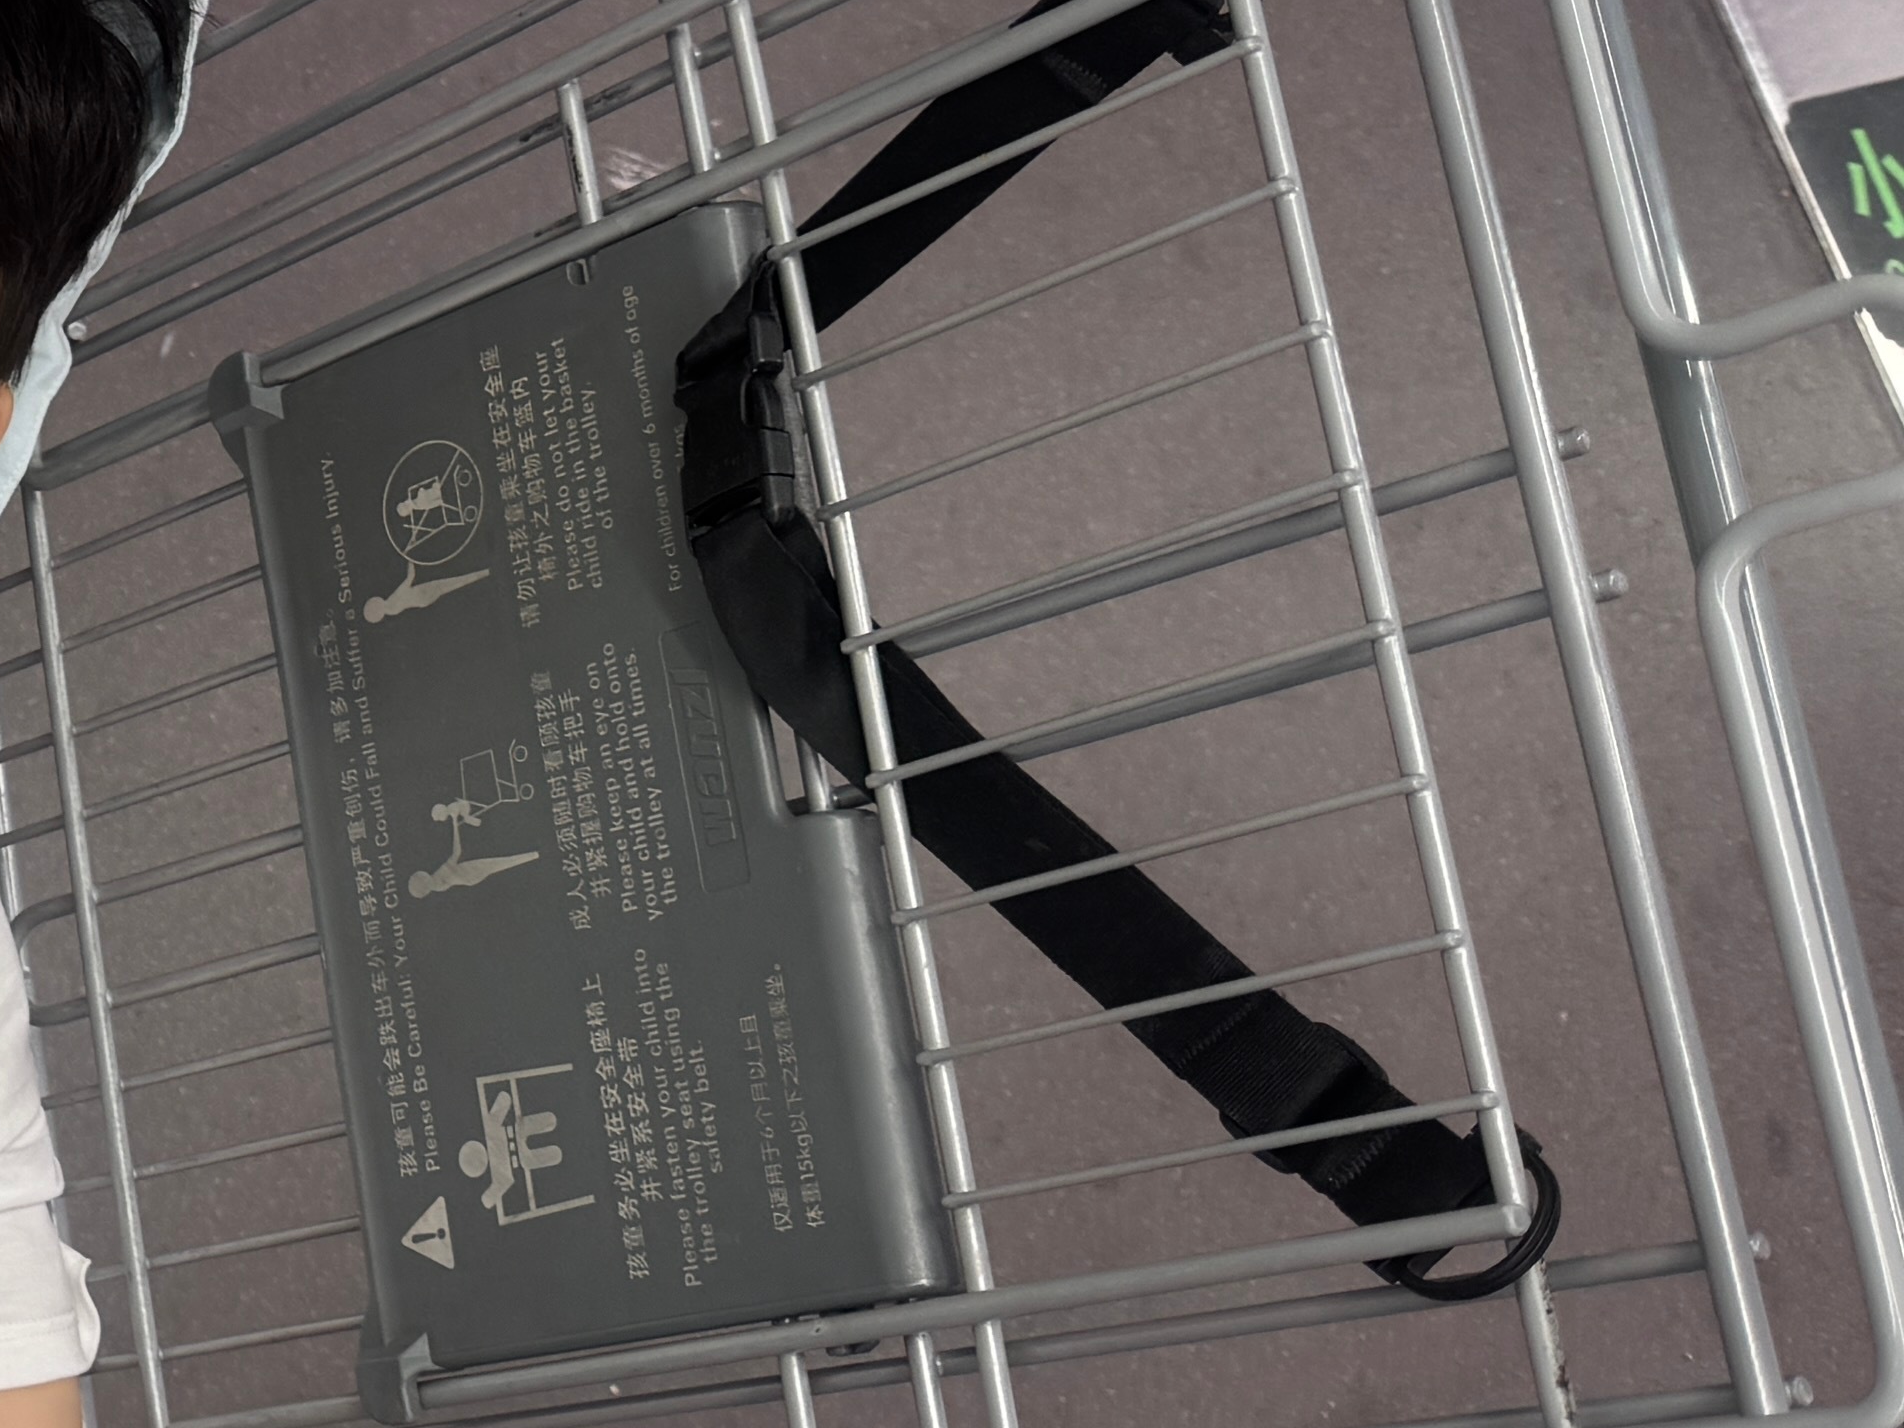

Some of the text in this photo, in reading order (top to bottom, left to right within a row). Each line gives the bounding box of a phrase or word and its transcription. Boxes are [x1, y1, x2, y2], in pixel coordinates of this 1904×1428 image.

[532, 349, 586, 590] Please do not let your
[547, 336, 605, 589] child ride in the basket
[589, 464, 611, 502] the
[619, 283, 685, 591] For children over 6 months of age
[327, 523, 353, 603] Serious
[595, 508, 614, 530] of
[343, 627, 366, 690] Suffer
[353, 696, 373, 735] and
[360, 741, 379, 779] Fall
[366, 784, 390, 847] Could
[557, 686, 612, 898] 并紧握购物车把手
[585, 661, 639, 912] Please keep an eye on
[599, 641, 664, 920] your child and hold onto
[619, 646, 679, 904] the trolley at all times.
[376, 852, 400, 909] Child
[387, 915, 408, 967] Your
[409, 1063, 428, 1093] Be
[615, 1034, 665, 1203] 并紧系安全带
[627, 947, 701, 1285] Please fasten your child into
[650, 961, 719, 1263] the trolley seat using the
[685, 1038, 727, 1174] safety belt.
[415, 1098, 441, 1172] Please
